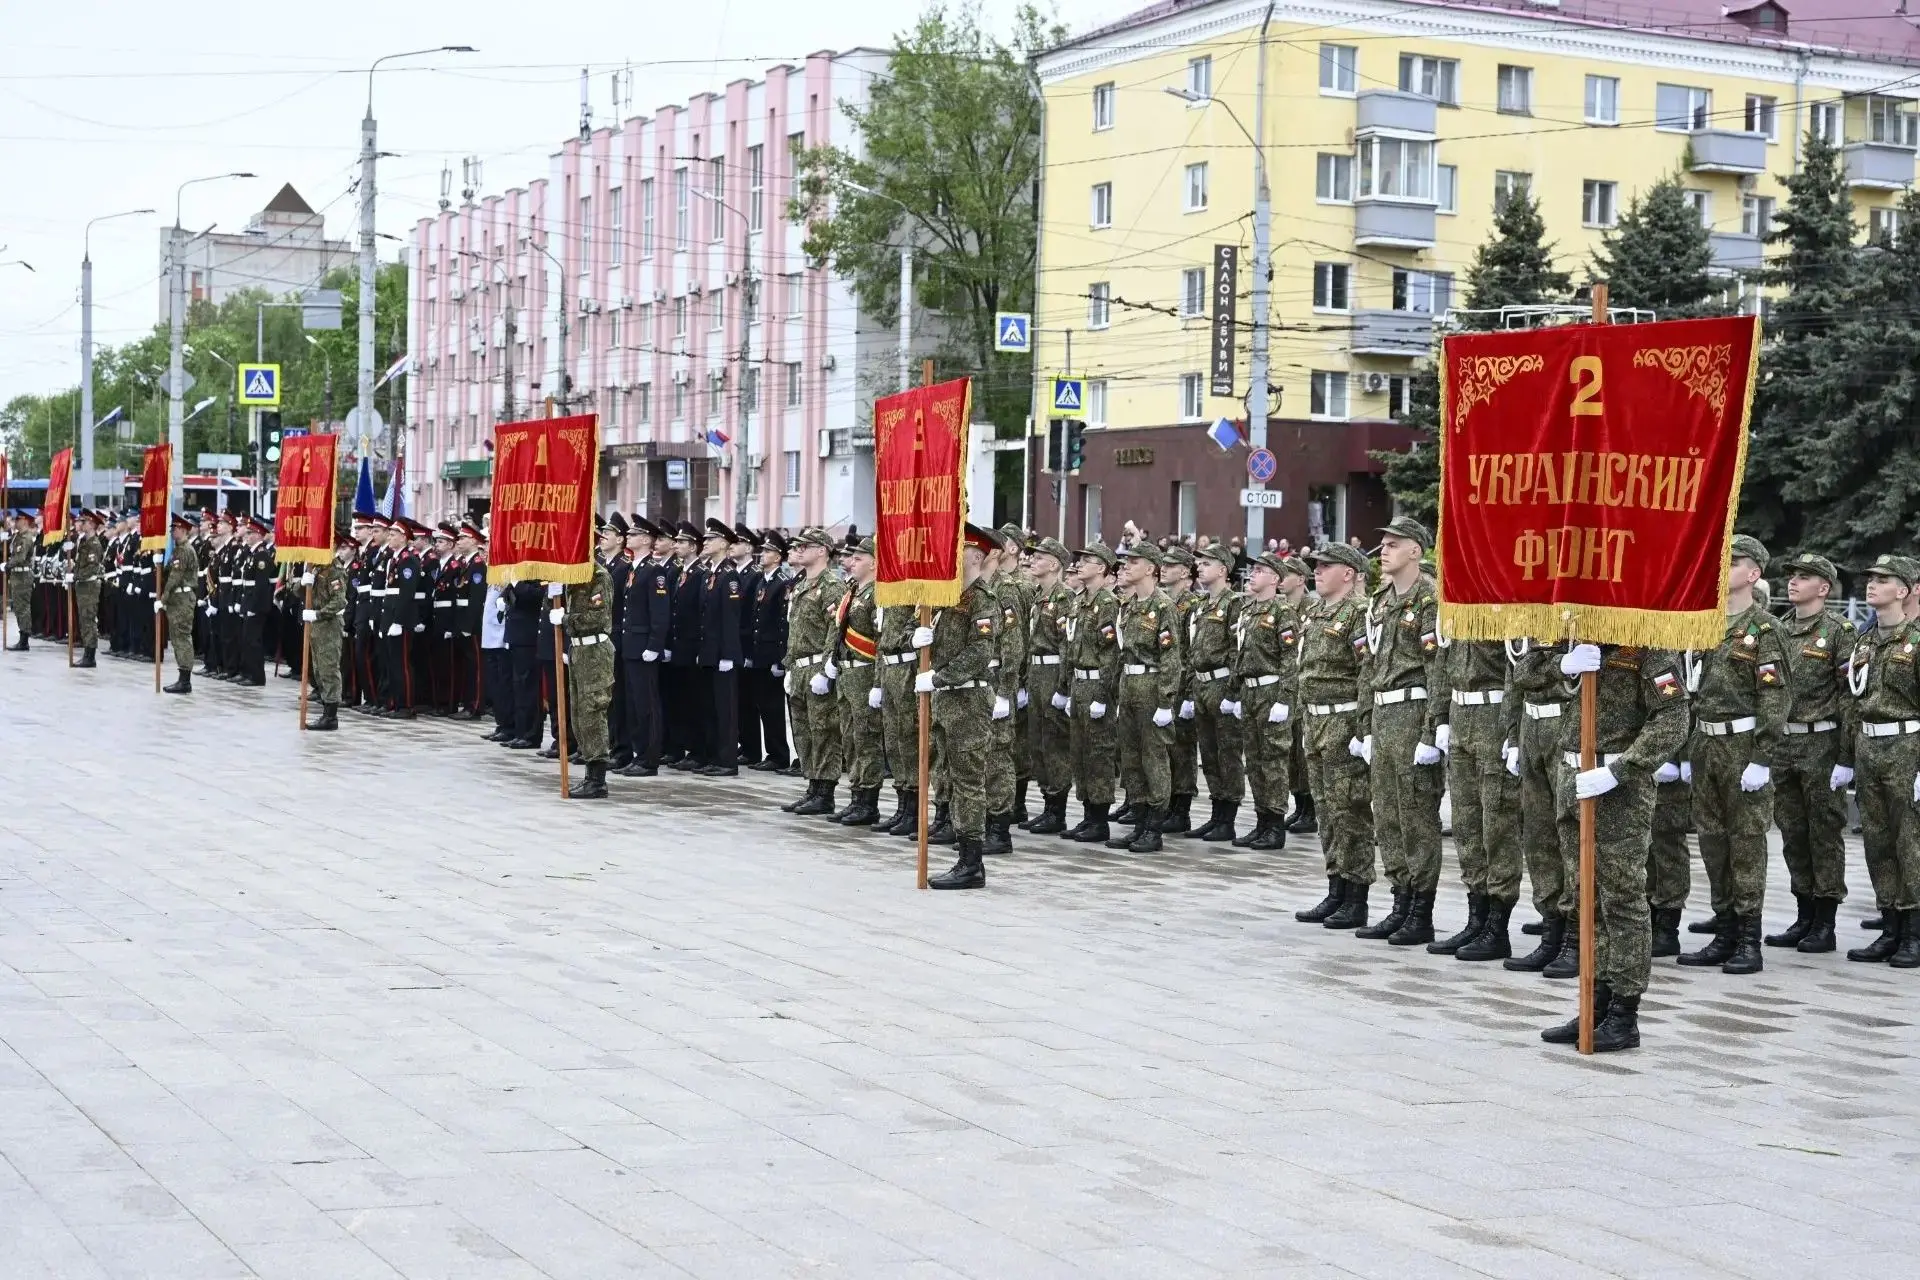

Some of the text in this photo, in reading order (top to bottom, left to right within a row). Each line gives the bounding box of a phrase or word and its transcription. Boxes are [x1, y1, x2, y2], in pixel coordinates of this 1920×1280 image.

[1219, 247, 1231, 306] САЛОН
[1218, 313, 1230, 372] ОБУВИ
[1569, 355, 1604, 417] 2
[302, 447, 311, 473] 2
[534, 434, 547, 466] 1
[1247, 492, 1277, 505] СТОП
